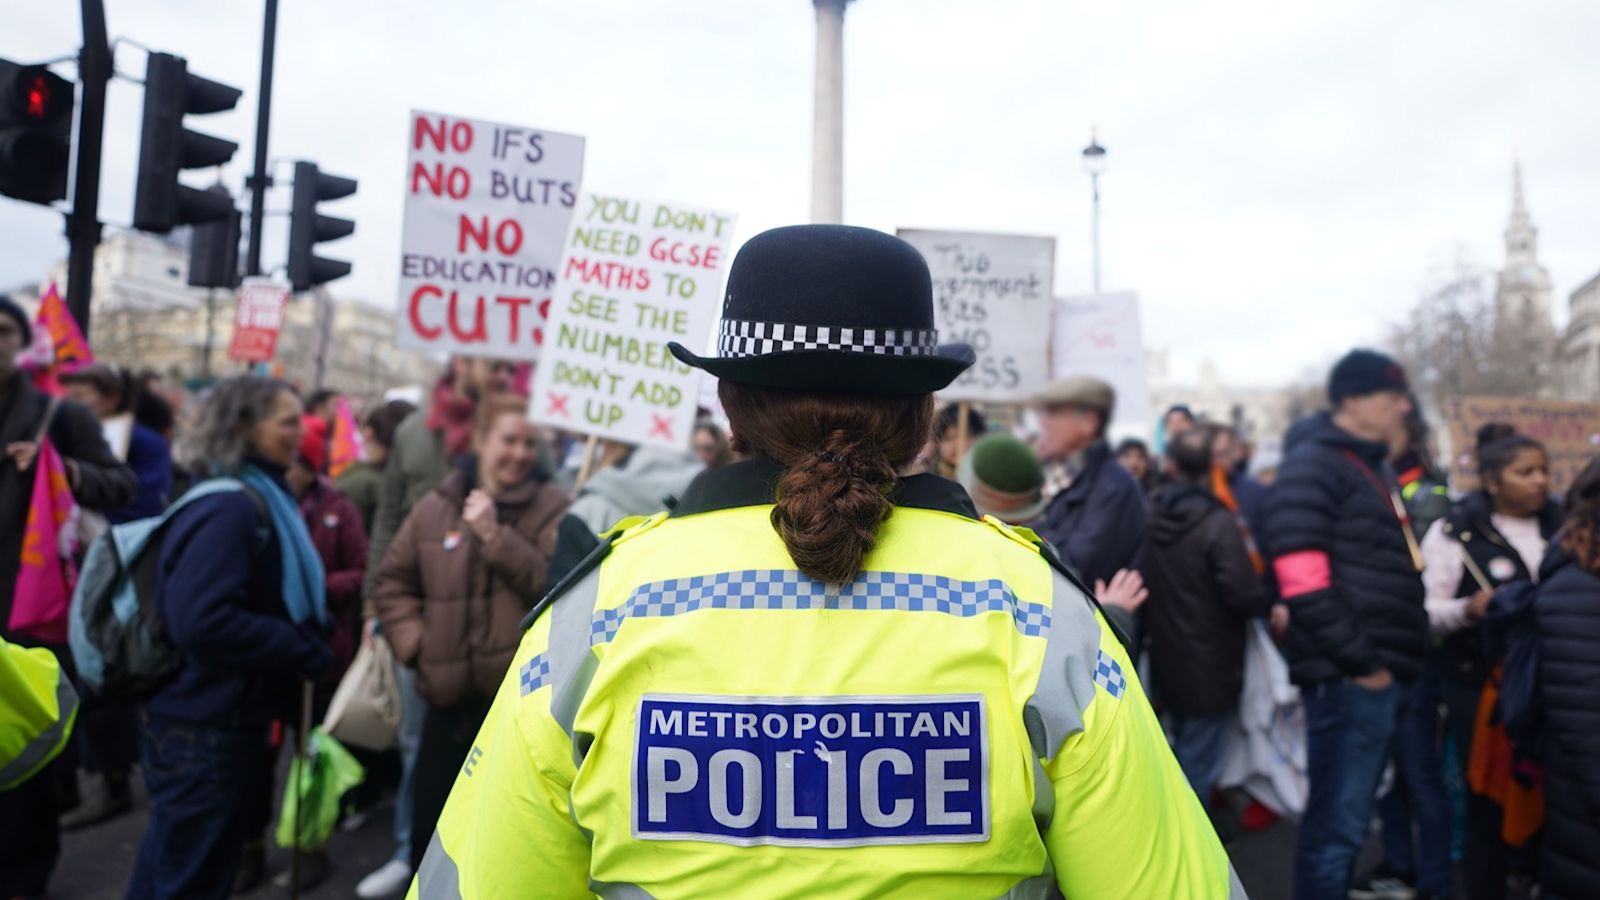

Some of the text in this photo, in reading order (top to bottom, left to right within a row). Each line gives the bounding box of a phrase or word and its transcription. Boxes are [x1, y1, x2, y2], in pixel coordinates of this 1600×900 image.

[413, 115, 545, 164] NO IFS
[410, 161, 577, 208] NO BUTS
[456, 213, 524, 257] NO
[586, 194, 731, 238] YOU DON'T
[572, 228, 721, 270] NEED GCSE
[564, 256, 697, 300] MATHS TO
[567, 289, 690, 335] SEE THE
[552, 361, 683, 409] DON'T ADD
[585, 399, 625, 427] UP
[649, 708, 972, 740] METROPOLITAN
[646, 746, 973, 831] POLICE
